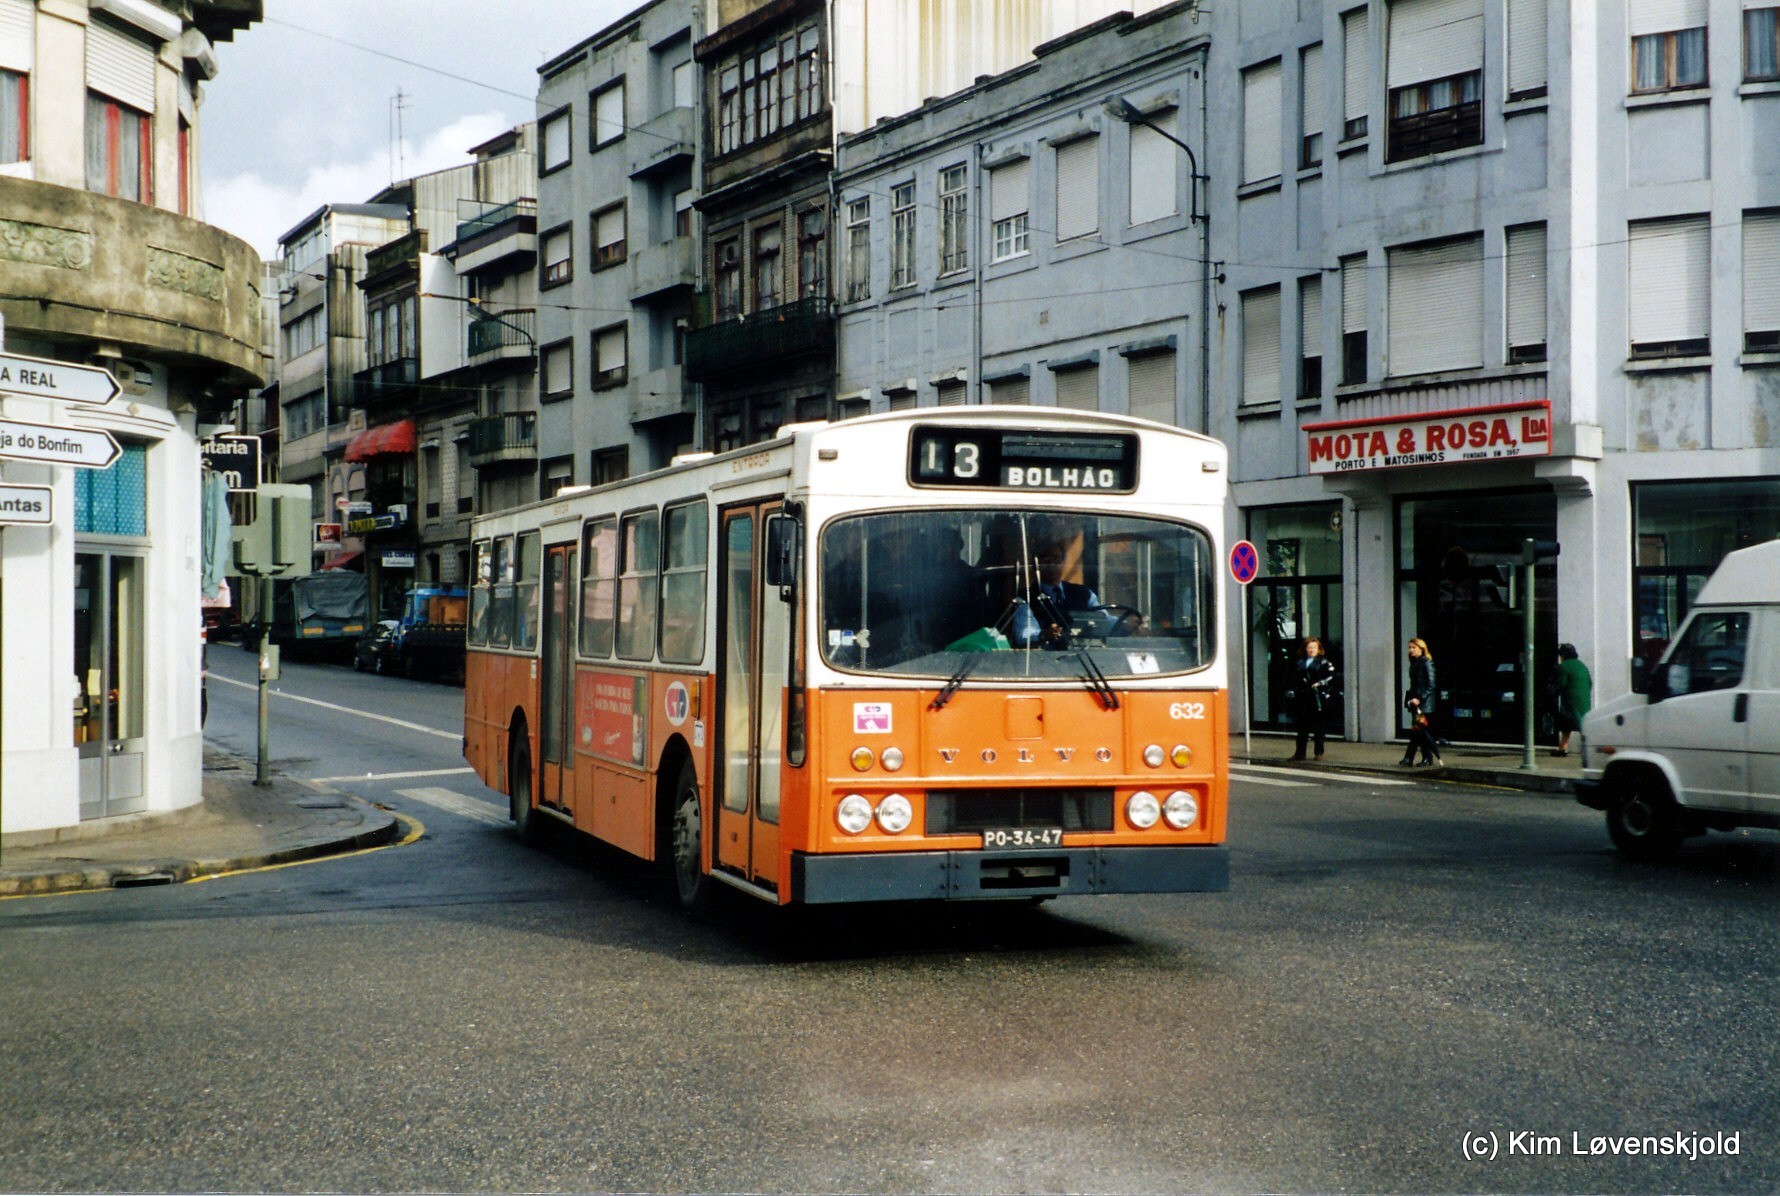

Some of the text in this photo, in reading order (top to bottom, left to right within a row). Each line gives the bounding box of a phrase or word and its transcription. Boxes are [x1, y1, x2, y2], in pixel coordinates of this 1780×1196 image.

[20, 369, 57, 388] REAL
[0, 430, 83, 454] ja do Bonfim
[1310, 430, 1388, 462] MOTA
[1396, 428, 1416, 454] &
[1426, 418, 1517, 451] ROSA,
[1335, 452, 1445, 470] PORTO E MATOSINHOS
[1008, 466, 1114, 488] BOLHÃO
[1169, 702, 1205, 719] 632
[938, 747, 1112, 764] VOLVO
[984, 829, 1063, 847] PO-34-47
